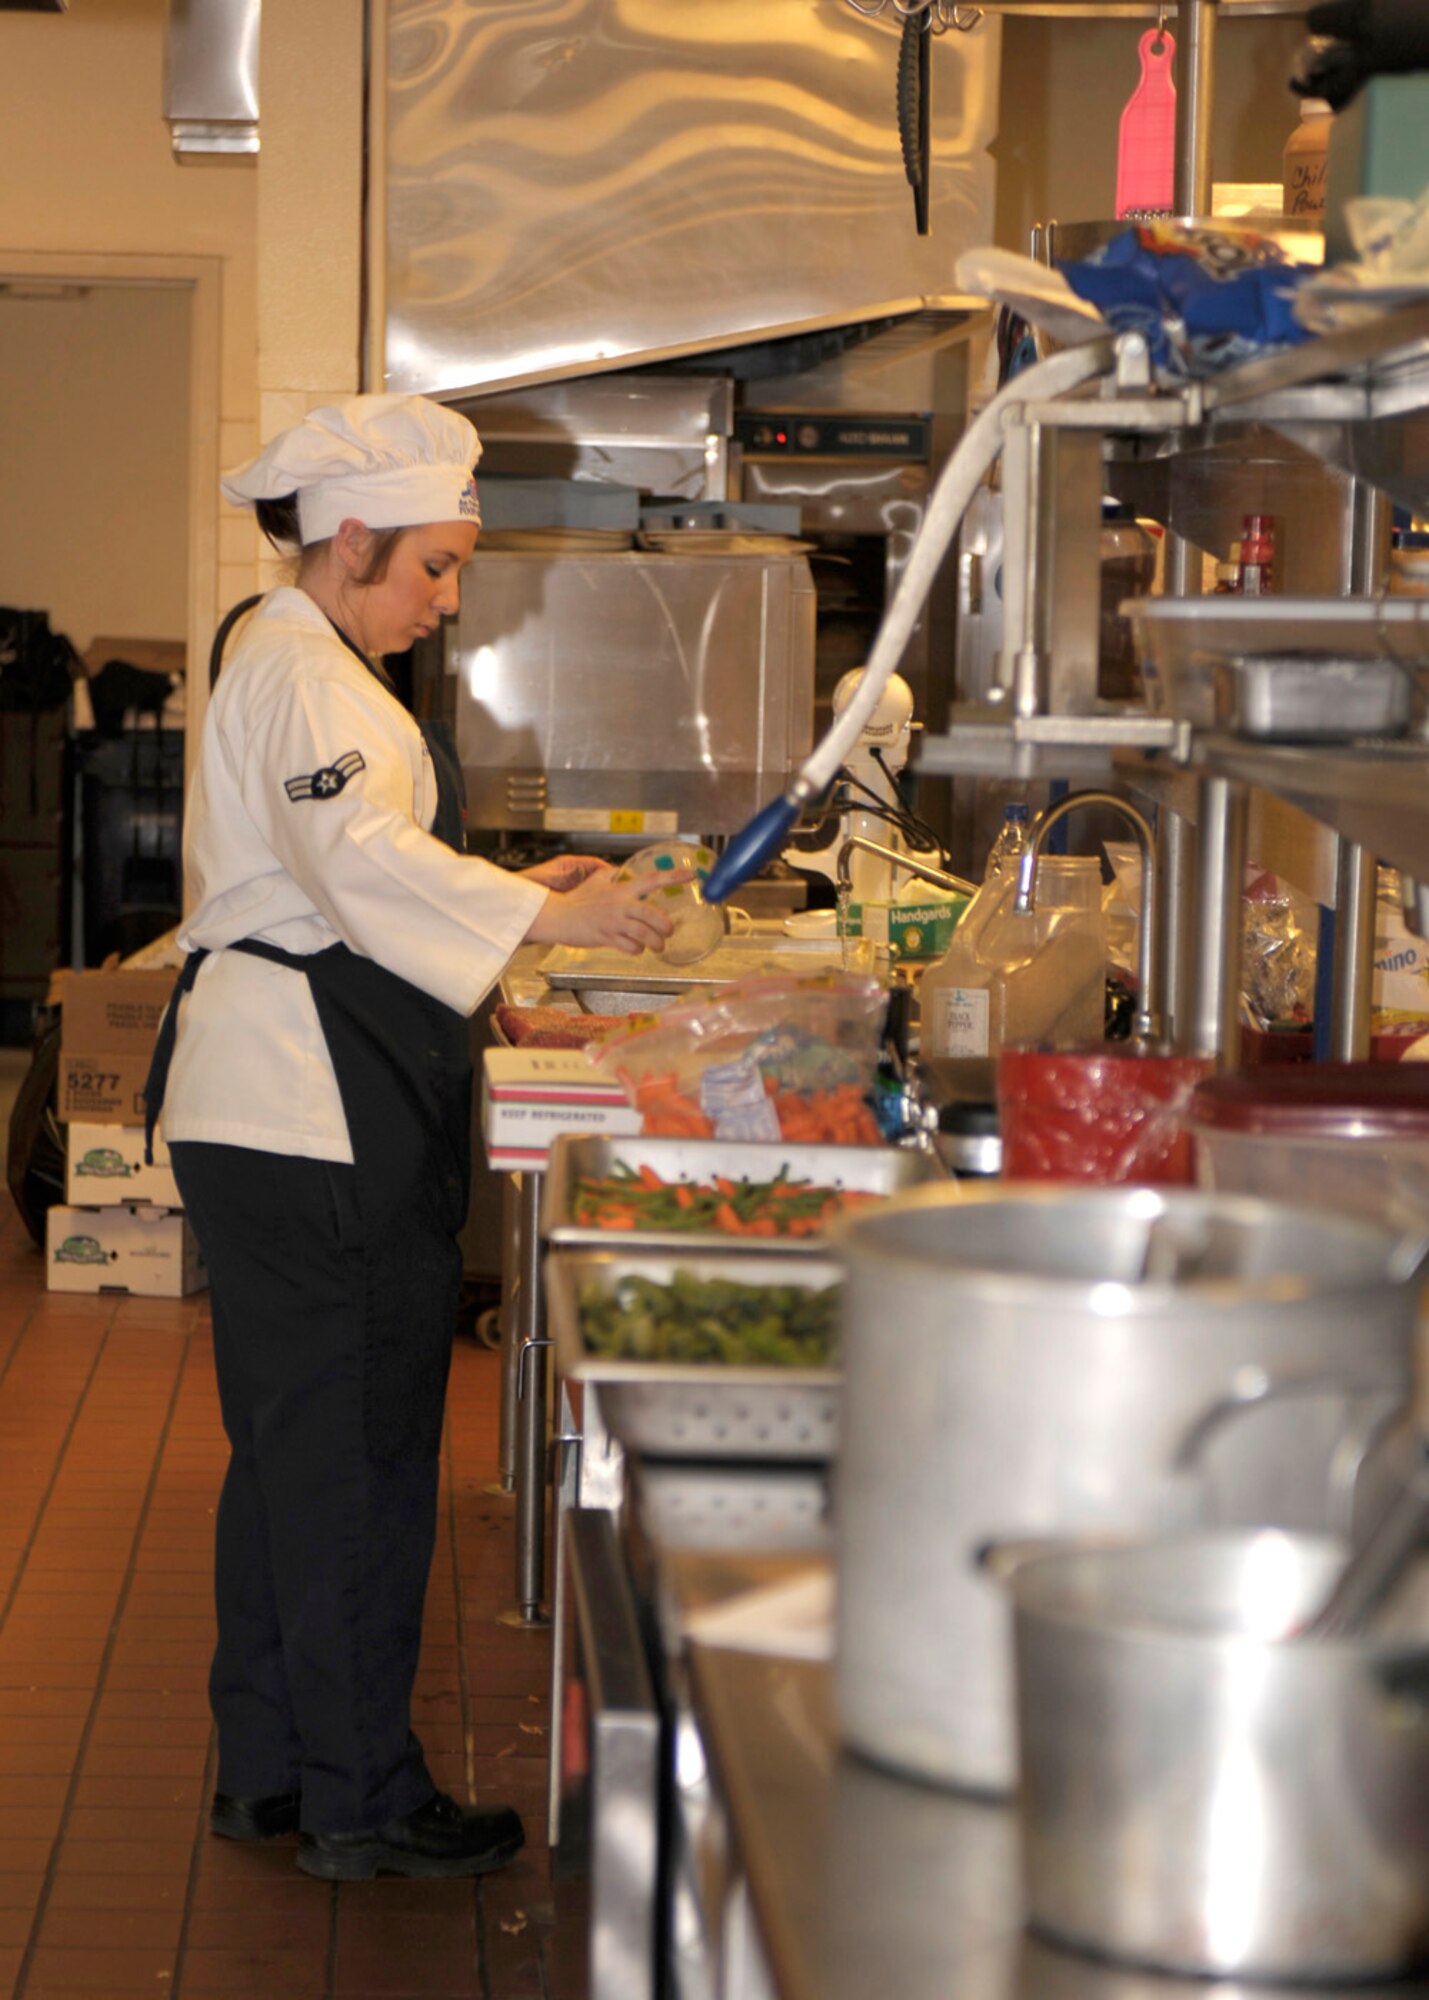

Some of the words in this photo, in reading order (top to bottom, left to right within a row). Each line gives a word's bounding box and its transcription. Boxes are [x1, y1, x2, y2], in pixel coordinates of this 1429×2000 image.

[891, 906, 952, 925] Handgards
[67, 1071, 121, 1091] 5277
[501, 1109, 527, 1119] KEEP
[531, 1110, 607, 1122] REFRIGERATED
